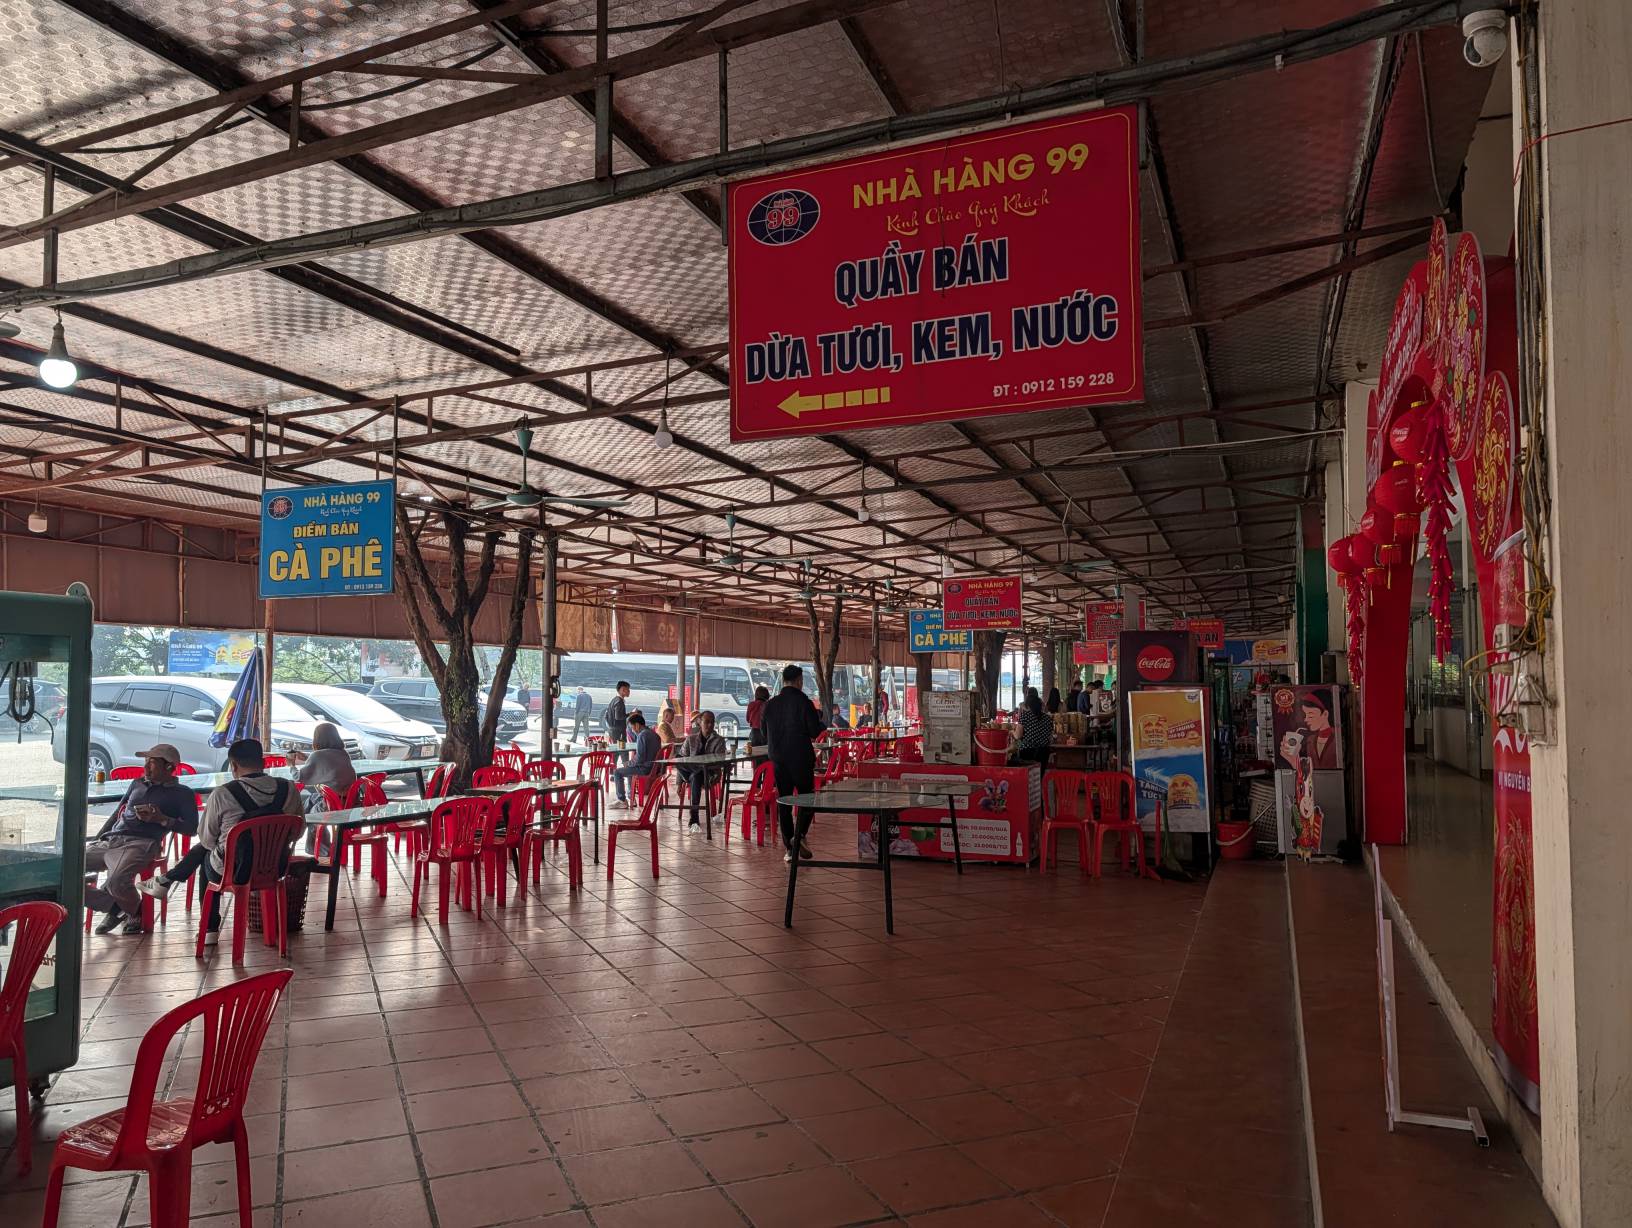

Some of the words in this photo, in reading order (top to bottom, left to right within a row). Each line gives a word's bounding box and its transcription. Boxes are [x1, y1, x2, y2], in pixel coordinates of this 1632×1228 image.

[853, 169, 922, 208] NHÀ
[933, 153, 1035, 195] HÀNG
[1045, 143, 1089, 174] 99
[767, 206, 799, 230] 99
[834, 240, 926, 308] QUẦY
[933, 232, 1009, 292] BÁN
[745, 331, 812, 385] DỪA
[818, 323, 904, 376] TƯƠI,
[912, 311, 1002, 365] KEM,
[1012, 289, 1119, 353] NƯỚC
[1021, 379, 1055, 395] 0912
[1060, 375, 1085, 389] 159
[1088, 372, 1115, 387] 228
[303, 493, 327, 508] NHÀ
[330, 491, 364, 506] HÀNG
[366, 492, 380, 503] 99
[293, 521, 326, 538] ĐIỂM
[330, 521, 359, 536] BÁN
[269, 542, 310, 581] CÀ
[320, 538, 383, 579] PHÊ
[914, 631, 934, 646] CÀ
